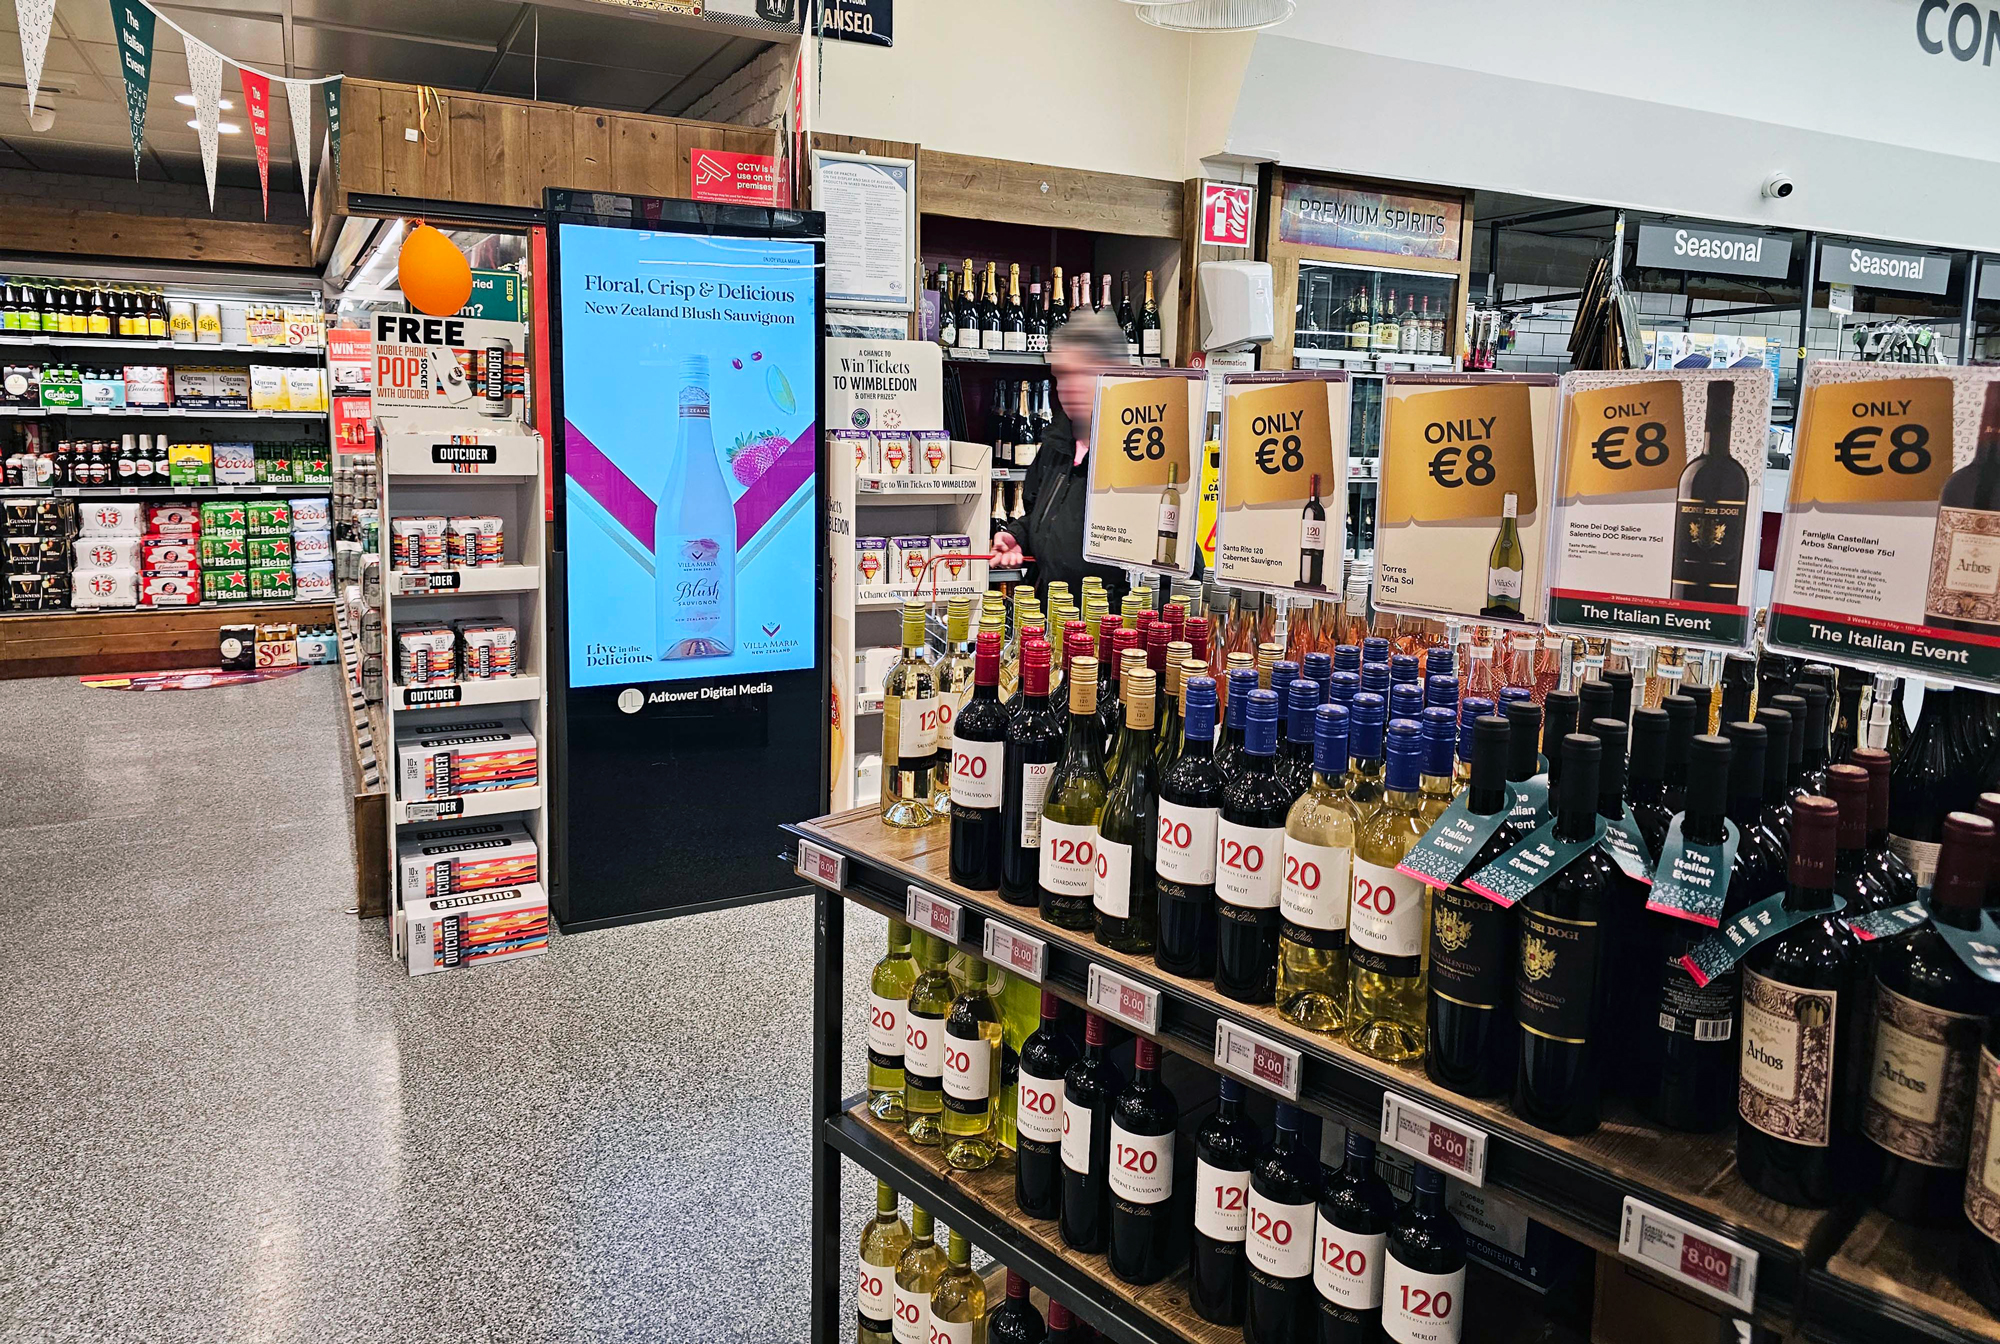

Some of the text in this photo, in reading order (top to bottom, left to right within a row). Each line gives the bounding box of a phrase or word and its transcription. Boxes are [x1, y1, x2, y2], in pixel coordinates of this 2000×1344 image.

[125, 8, 139, 31] The
[123, 28, 145, 56] Italian
[126, 52, 145, 78] Event
[737, 162, 760, 172] CCTV
[1300, 198, 1446, 235] PREMIUM SPIRITS
[1673, 229, 1763, 263] Seasonal
[1850, 248, 1925, 280] Seasonal
[585, 275, 795, 303] Floral, Crisp & Delicious
[585, 301, 795, 327] New Zealand Blush Sauvignon
[377, 316, 465, 346] FREE
[331, 342, 354, 355] WIN
[377, 344, 403, 357] MOBILE
[405, 346, 428, 357] PHONE
[863, 350, 884, 358] CHANCE
[841, 358, 910, 375] Win Tickets
[1212, 358, 1247, 367] Information
[378, 356, 428, 389] POP SOCKET
[833, 376, 917, 392] TO WIMBLEDON
[45, 389, 79, 402] Carlsberg
[377, 388, 429, 400] WITH OUTCIDER
[1121, 404, 1167, 426] ONLY
[1603, 401, 1651, 419] ONLY
[1852, 400, 1912, 418] ONLY
[1252, 410, 1304, 436] ONLY
[1424, 416, 1497, 444] ONLY
[1123, 426, 1166, 462] €8
[1591, 422, 1670, 470] €8
[1834, 423, 1932, 476] €8
[214, 457, 254, 470] Coors
[1255, 437, 1304, 475] €8
[1428, 444, 1496, 488] €8
[97, 512, 119, 525] 13
[1570, 522, 1589, 530] Rione
[1603, 524, 1619, 532] Dogi
[1091, 523, 1105, 532] Santa
[1106, 525, 1117, 533] Rita
[1569, 530, 1601, 538] Salentino
[1620, 534, 1647, 542] Riserva
[1090, 540, 1101, 548] 75cl
[1091, 532, 1133, 544] Sauvignon Blanc
[1802, 530, 1880, 546] Famiglia Castellani
[1800, 539, 1895, 557] Arbos Sangiovese 75cl
[1222, 553, 1283, 567] Cabernet Sauvignon
[1222, 562, 1234, 570] 75cl
[1382, 564, 1407, 574] Torres
[1381, 573, 1414, 585] Viña Sol
[673, 577, 720, 603] Blush
[1380, 585, 1397, 594] 75cl
[678, 599, 717, 607] SAUVIGNON
[1581, 604, 1712, 631] The Italian Event
[586, 643, 617, 655] Live
[619, 645, 627, 653] in
[743, 639, 799, 650] VILLA MARIA
[1809, 623, 1970, 665] The Italian Event
[586, 653, 653, 667] Delicious
[648, 682, 773, 704] Adtower Digital Media
[952, 751, 987, 779] 120
[1030, 765, 1046, 775] 120
[1158, 814, 1192, 849] 120
[1455, 817, 1475, 833] The
[1440, 826, 1473, 845] Italian
[1051, 838, 1093, 865] 120
[1433, 836, 1464, 854] Event
[1160, 858, 1178, 870] MERLOT
[1684, 849, 1710, 864] The
[1674, 857, 1715, 877] Italian
[1052, 877, 1087, 888] CHARDONNAY
[1672, 869, 1712, 888] Event
[1547, 925, 1580, 942] DOGI
[1745, 1040, 1784, 1071] Arbos
[1117, 1143, 1158, 1174] 120
[1111, 1174, 1162, 1195] CABERNET SAUVIGNON
[1251, 1206, 1293, 1246] 120
[1256, 1250, 1277, 1265] MERLOT
[1476, 1241, 1512, 1266] CONTENT
